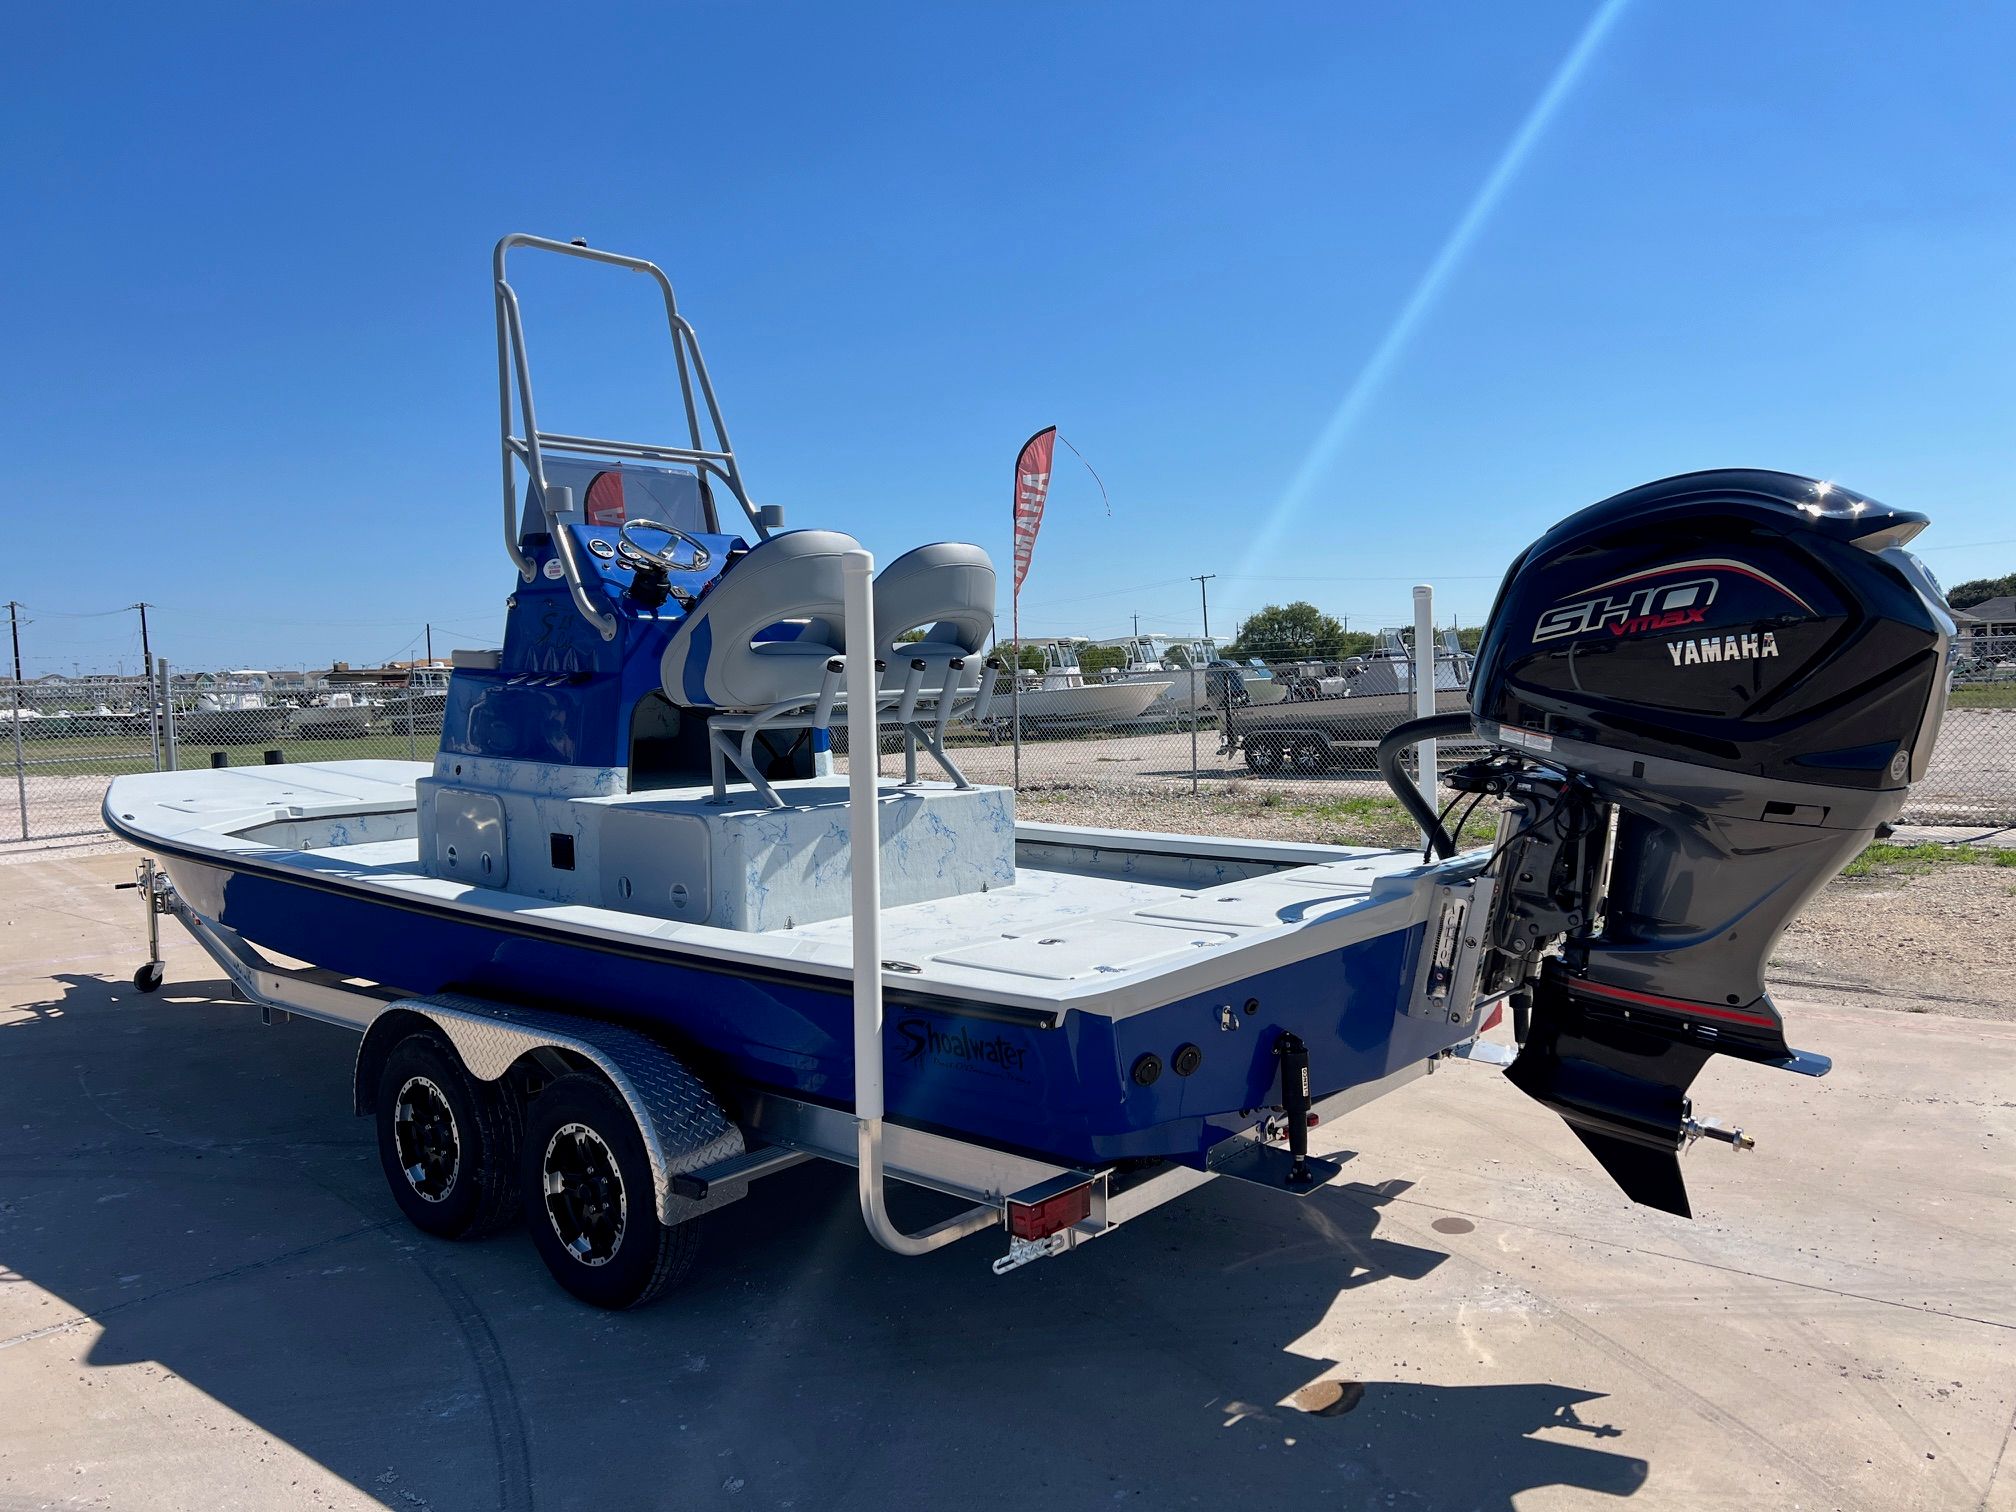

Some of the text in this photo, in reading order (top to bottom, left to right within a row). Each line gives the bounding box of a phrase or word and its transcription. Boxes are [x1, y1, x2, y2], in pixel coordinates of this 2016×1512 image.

[1015, 473, 1048, 587] AMAHA
[1532, 577, 1719, 643] SHO
[1667, 631, 1779, 666] YAMAHA
[896, 1018, 1027, 1072] Shoalwater
